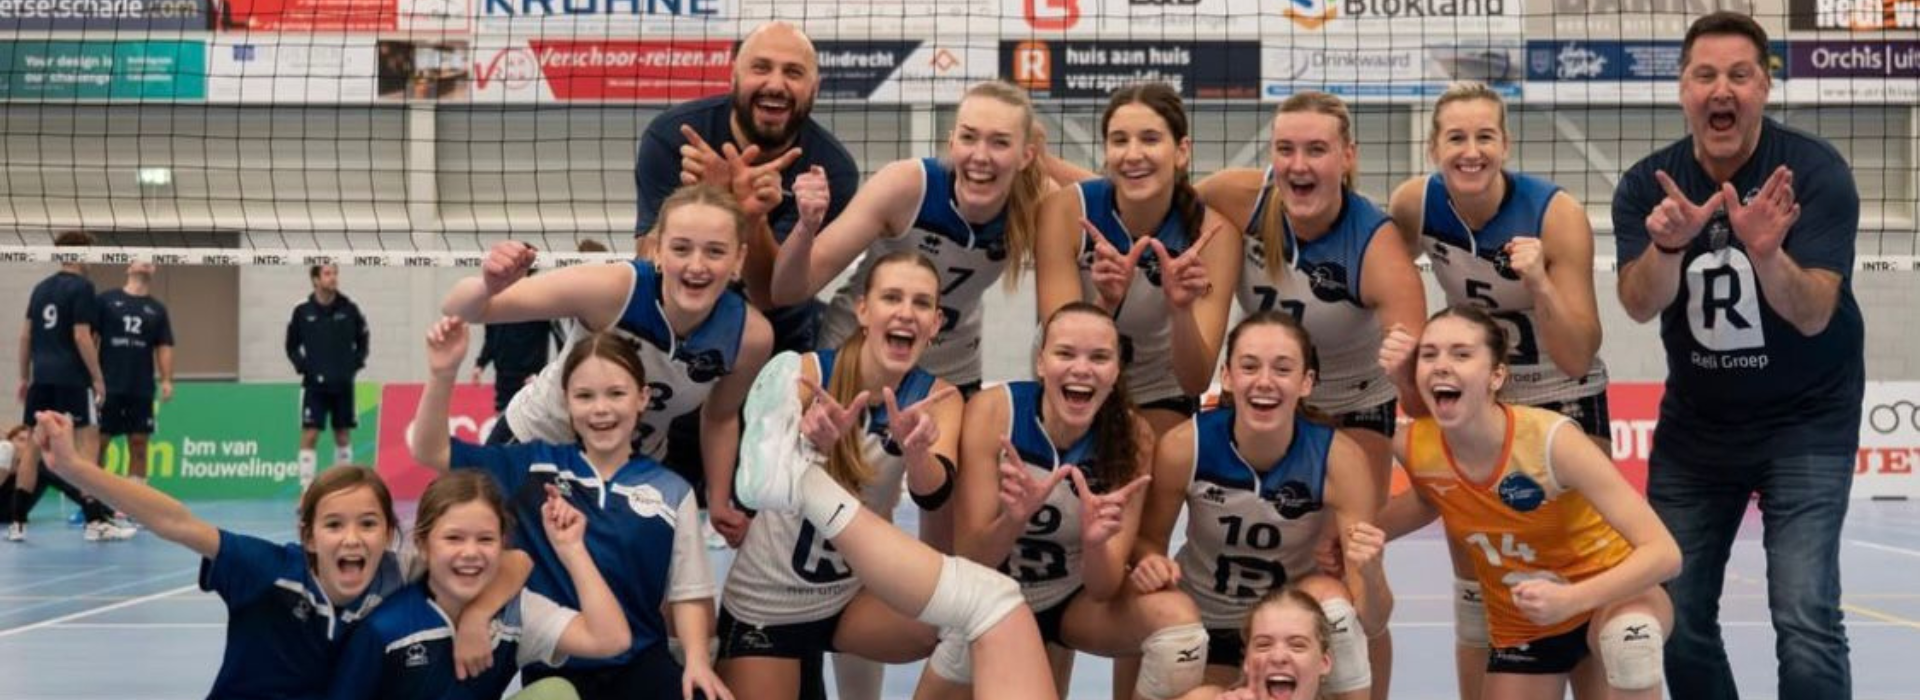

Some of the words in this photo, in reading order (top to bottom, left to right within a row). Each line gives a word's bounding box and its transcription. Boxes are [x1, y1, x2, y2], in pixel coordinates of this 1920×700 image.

[58, 55, 99, 70] design
[540, 45, 731, 68] Verschoor-reizen.nl
[818, 50, 894, 68] liedrecht
[1021, 49, 1046, 80] R
[1065, 47, 1107, 65] huis
[1110, 50, 1146, 65] aan
[1149, 46, 1191, 65] huis
[1312, 53, 1411, 69] Drinkwaard
[1811, 45, 1882, 69] Orchis
[941, 266, 976, 296] 7
[1465, 278, 1499, 309] 5
[1702, 264, 1753, 330] R
[42, 303, 58, 330] 9
[122, 314, 143, 334] 12
[1691, 351, 1718, 369] Reli
[1721, 353, 1769, 369] Groep
[183, 436, 216, 456] bm
[222, 440, 258, 456] van
[181, 456, 300, 482] houwelinge
[1026, 503, 1063, 535] 9
[1218, 514, 1282, 551] 10
[1466, 532, 1538, 567] 14
